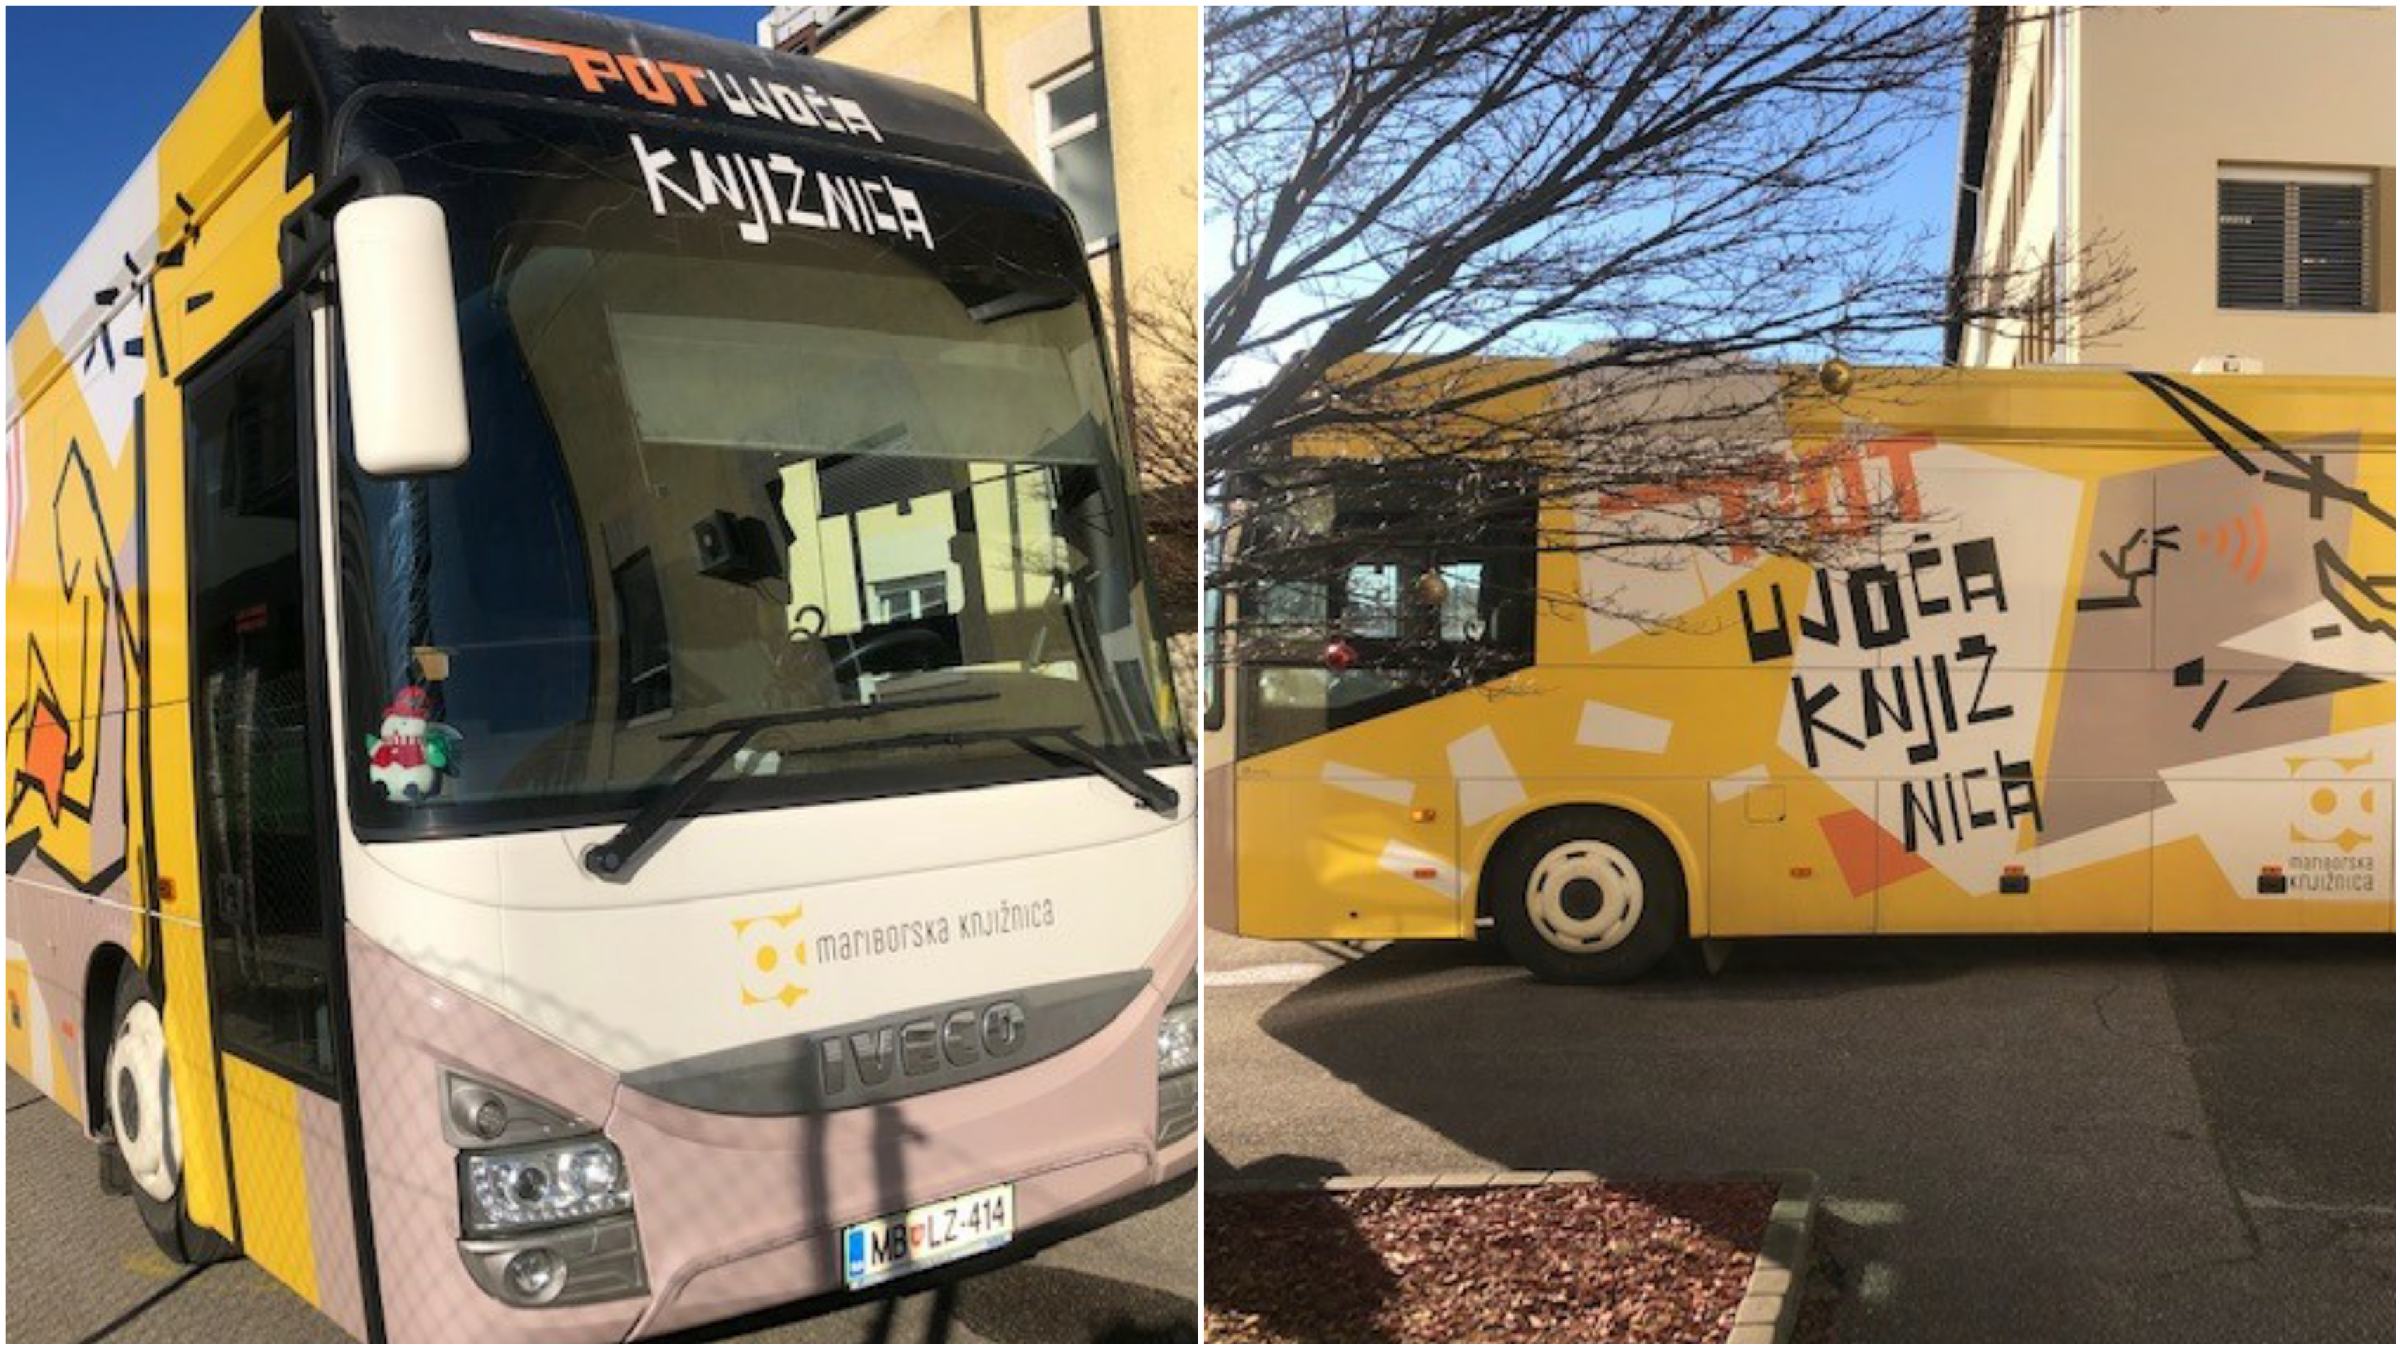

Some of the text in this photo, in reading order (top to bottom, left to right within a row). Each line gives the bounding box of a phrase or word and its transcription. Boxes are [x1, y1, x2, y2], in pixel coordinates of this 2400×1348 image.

[629, 133, 935, 251] KNJIŽNICA
[1599, 431, 1937, 564] POT
[1902, 750, 2044, 853] NICA
[818, 1000, 1026, 1097] IVECO
[872, 1195, 1005, 1266] MB LZ-414
